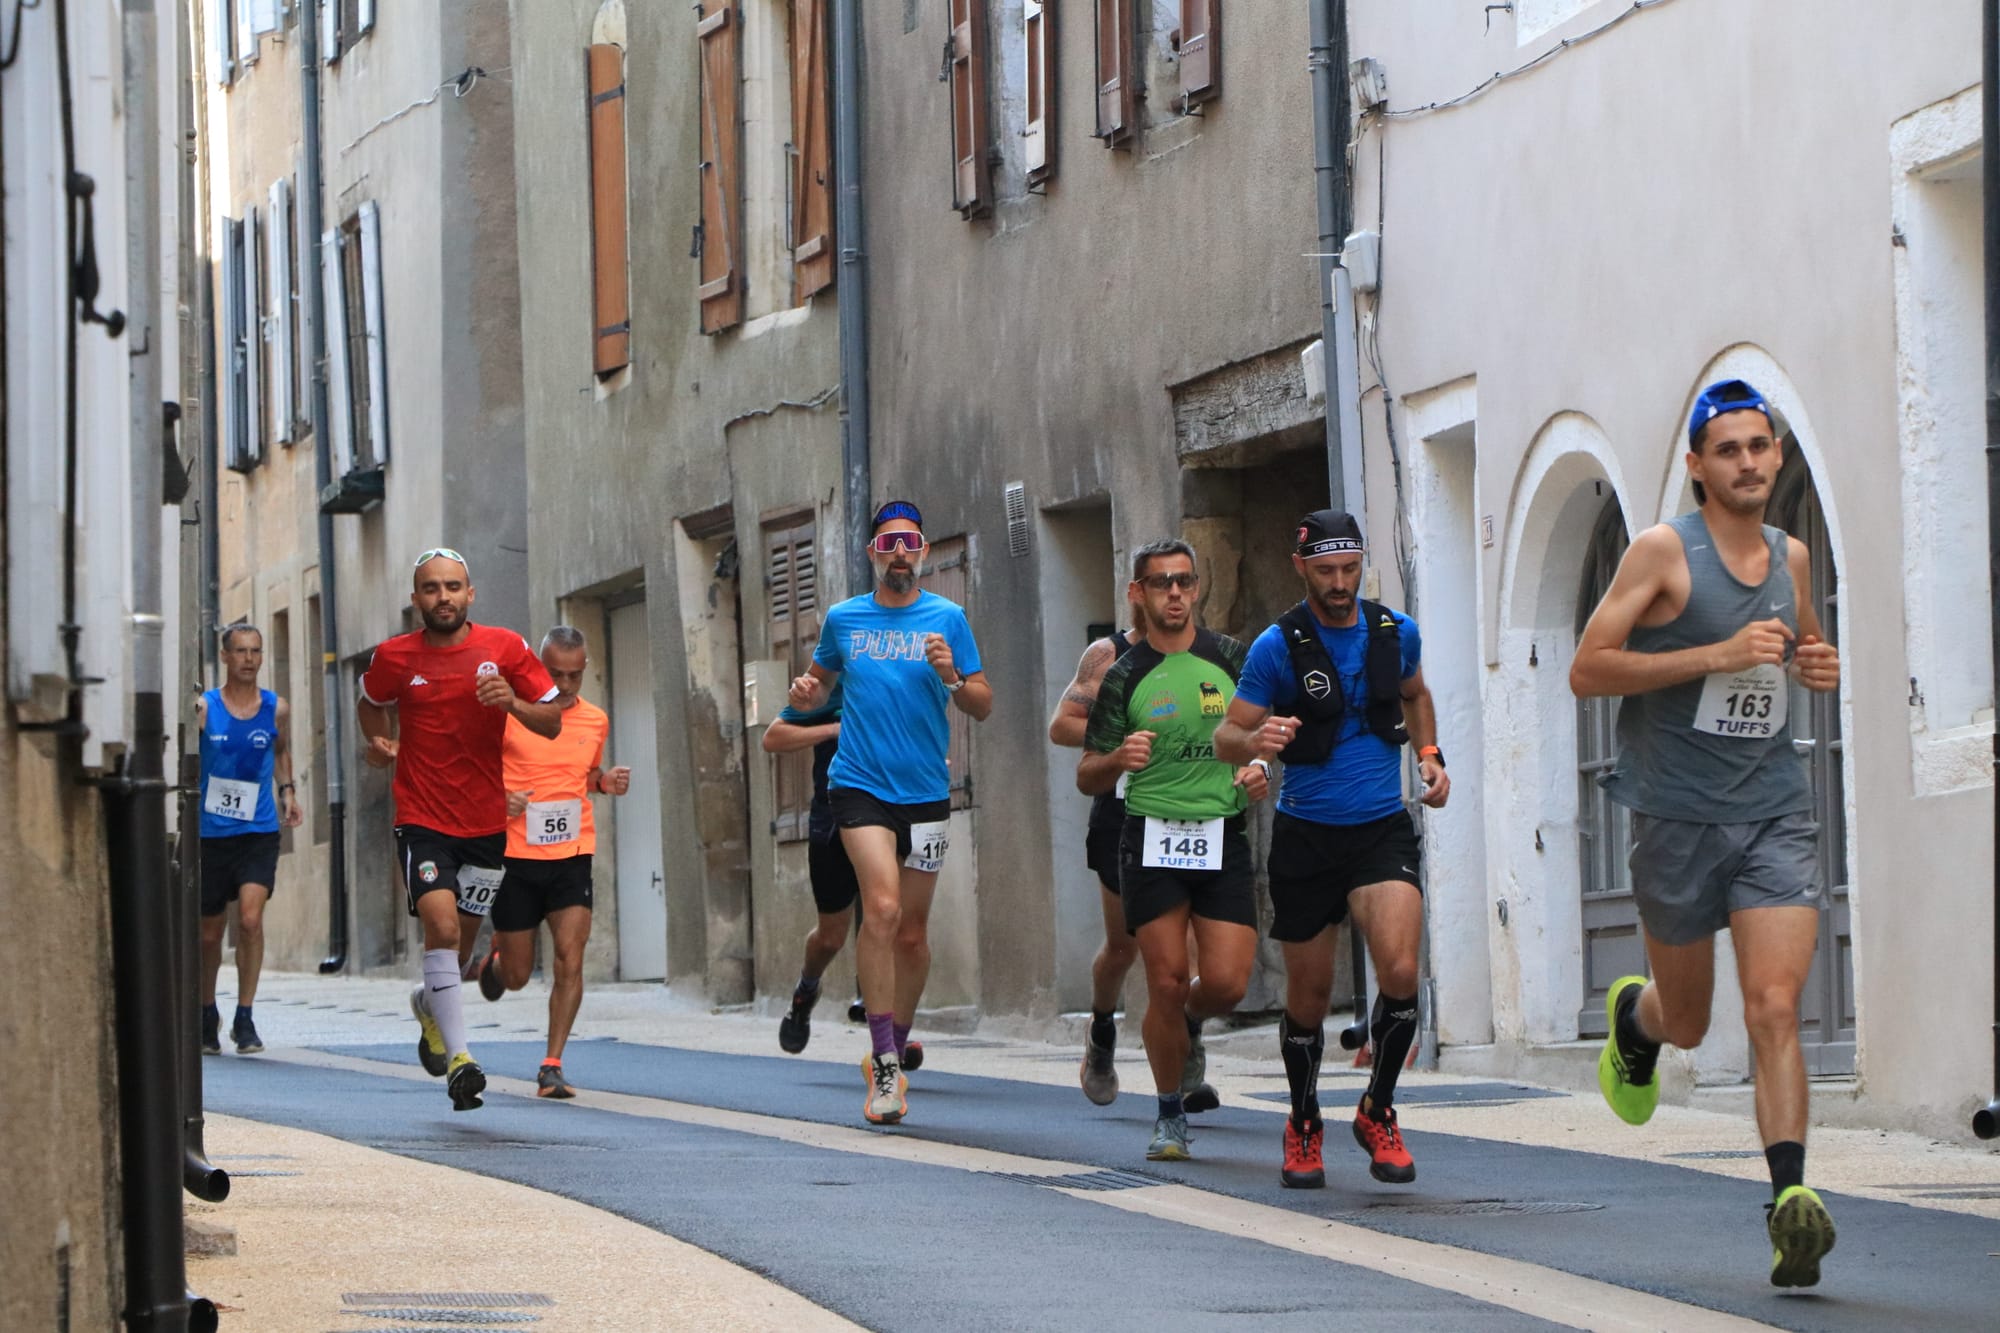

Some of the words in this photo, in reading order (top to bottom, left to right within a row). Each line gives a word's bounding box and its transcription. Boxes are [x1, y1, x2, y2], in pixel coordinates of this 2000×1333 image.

[1203, 700, 1224, 714] eni
[1726, 693, 1773, 719] 163
[1716, 719, 1771, 735] TUFF'S
[221, 794, 241, 809] 31
[545, 818, 567, 833] 56
[538, 832, 571, 844] TUFF'S
[1159, 837, 1208, 857] 148
[1158, 856, 1207, 868] TUFF'S
